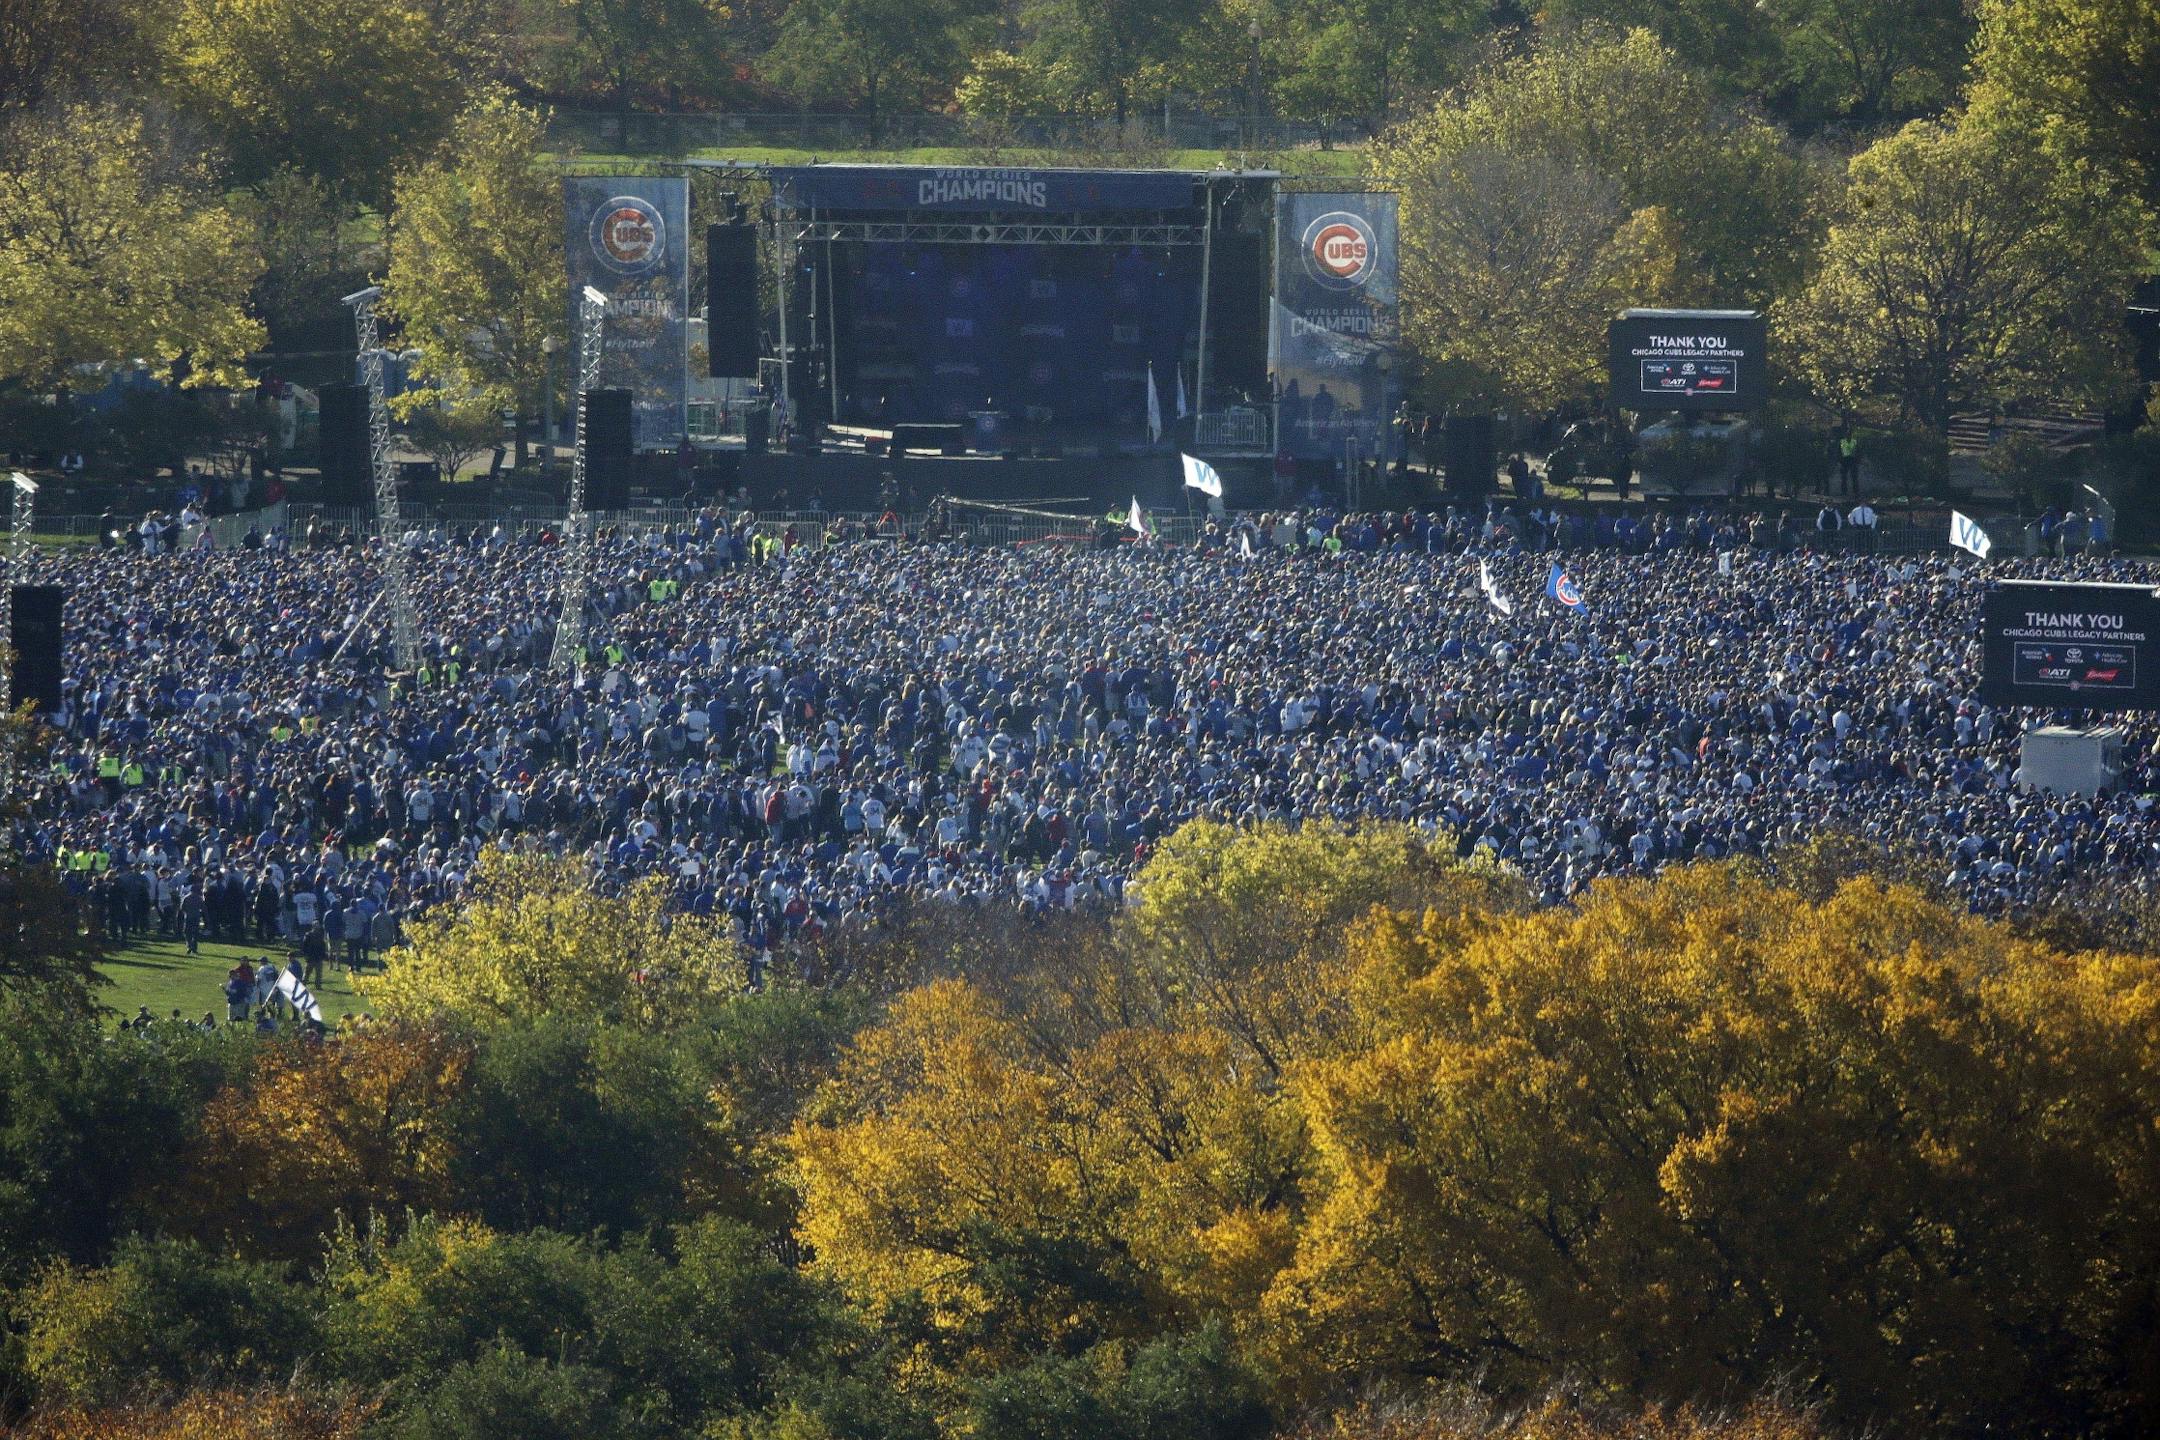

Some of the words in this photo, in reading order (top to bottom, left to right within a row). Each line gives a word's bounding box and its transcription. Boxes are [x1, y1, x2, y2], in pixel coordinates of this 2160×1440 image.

[936, 170, 980, 179] WORLD
[985, 170, 1031, 181] SERIES
[919, 179, 1047, 208] CHAMPIONS
[1313, 224, 1368, 278] CUBS
[581, 299, 675, 322] AMPION
[1305, 308, 1338, 316] WORLD
[1649, 335, 1696, 348] THANK
[1698, 337, 1727, 348] YOU
[1631, 348, 1663, 356] CHICAGO
[1683, 349, 1709, 357] LEGACY
[1710, 349, 1744, 357] PARTNERS
[1959, 516, 1985, 551] W
[2025, 612, 2083, 628] THANK
[2087, 614, 2123, 629] YOU
[2003, 628, 2042, 637] CHICAGO
[2044, 630, 2067, 638] CUBS
[2068, 631, 2101, 639] LEGACY
[2102, 632, 2146, 641] PARTNERS
[2050, 668, 2071, 676] ATI
